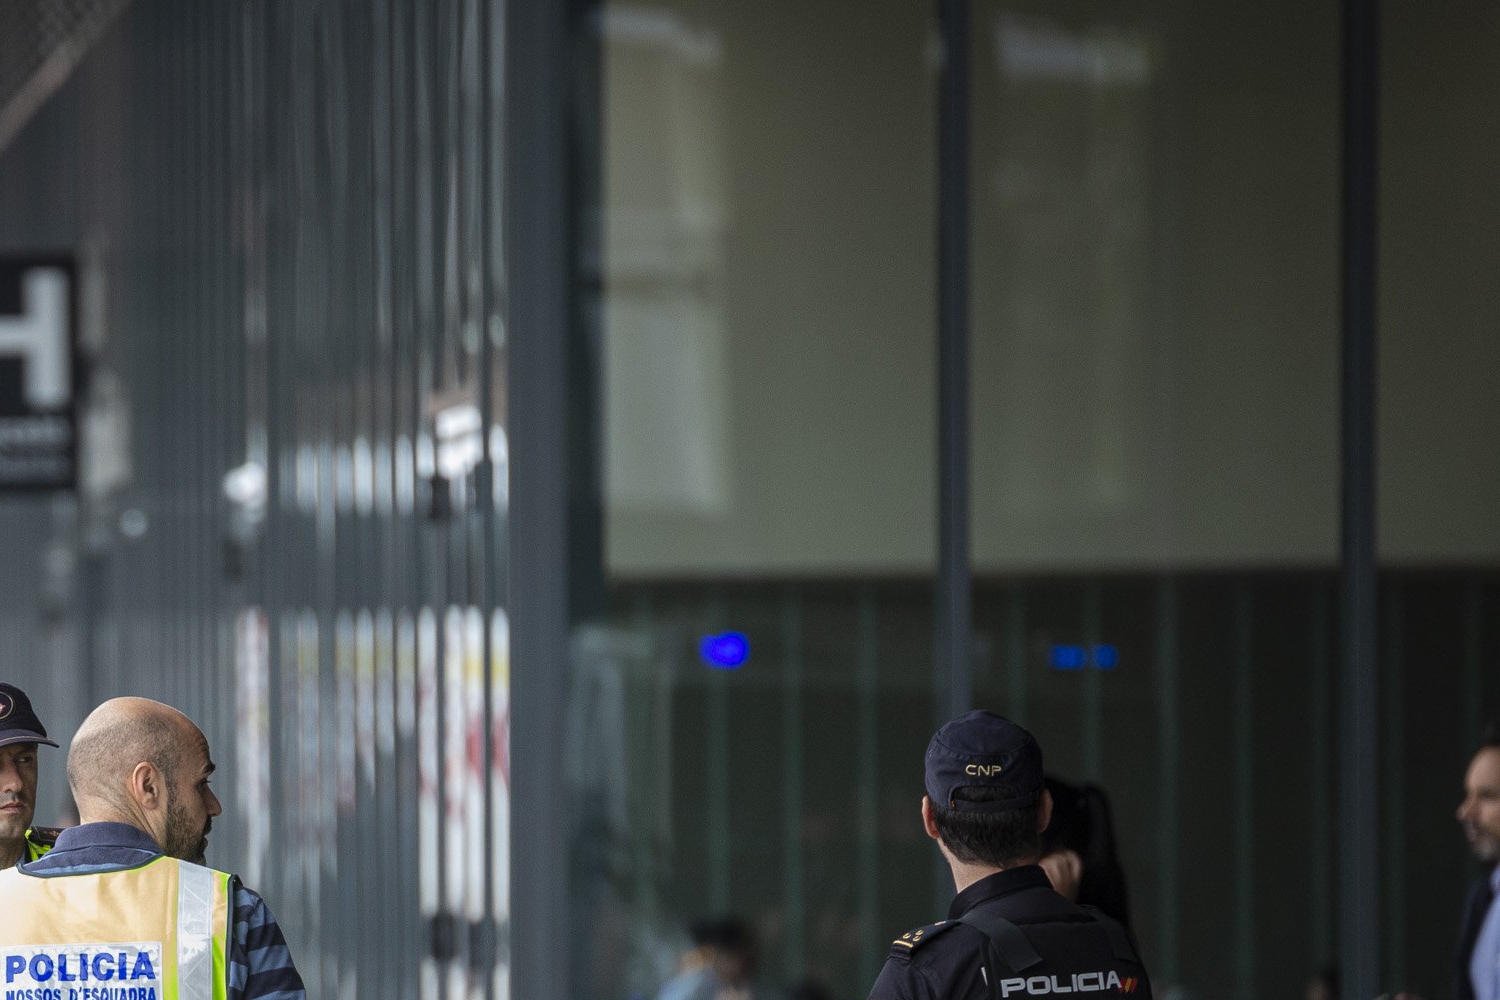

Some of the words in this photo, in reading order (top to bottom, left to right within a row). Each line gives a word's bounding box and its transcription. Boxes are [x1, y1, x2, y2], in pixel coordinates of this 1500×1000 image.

[965, 764, 1002, 776] CNP
[5, 951, 156, 983] POLICIA
[1000, 970, 1122, 998] POLICIA
